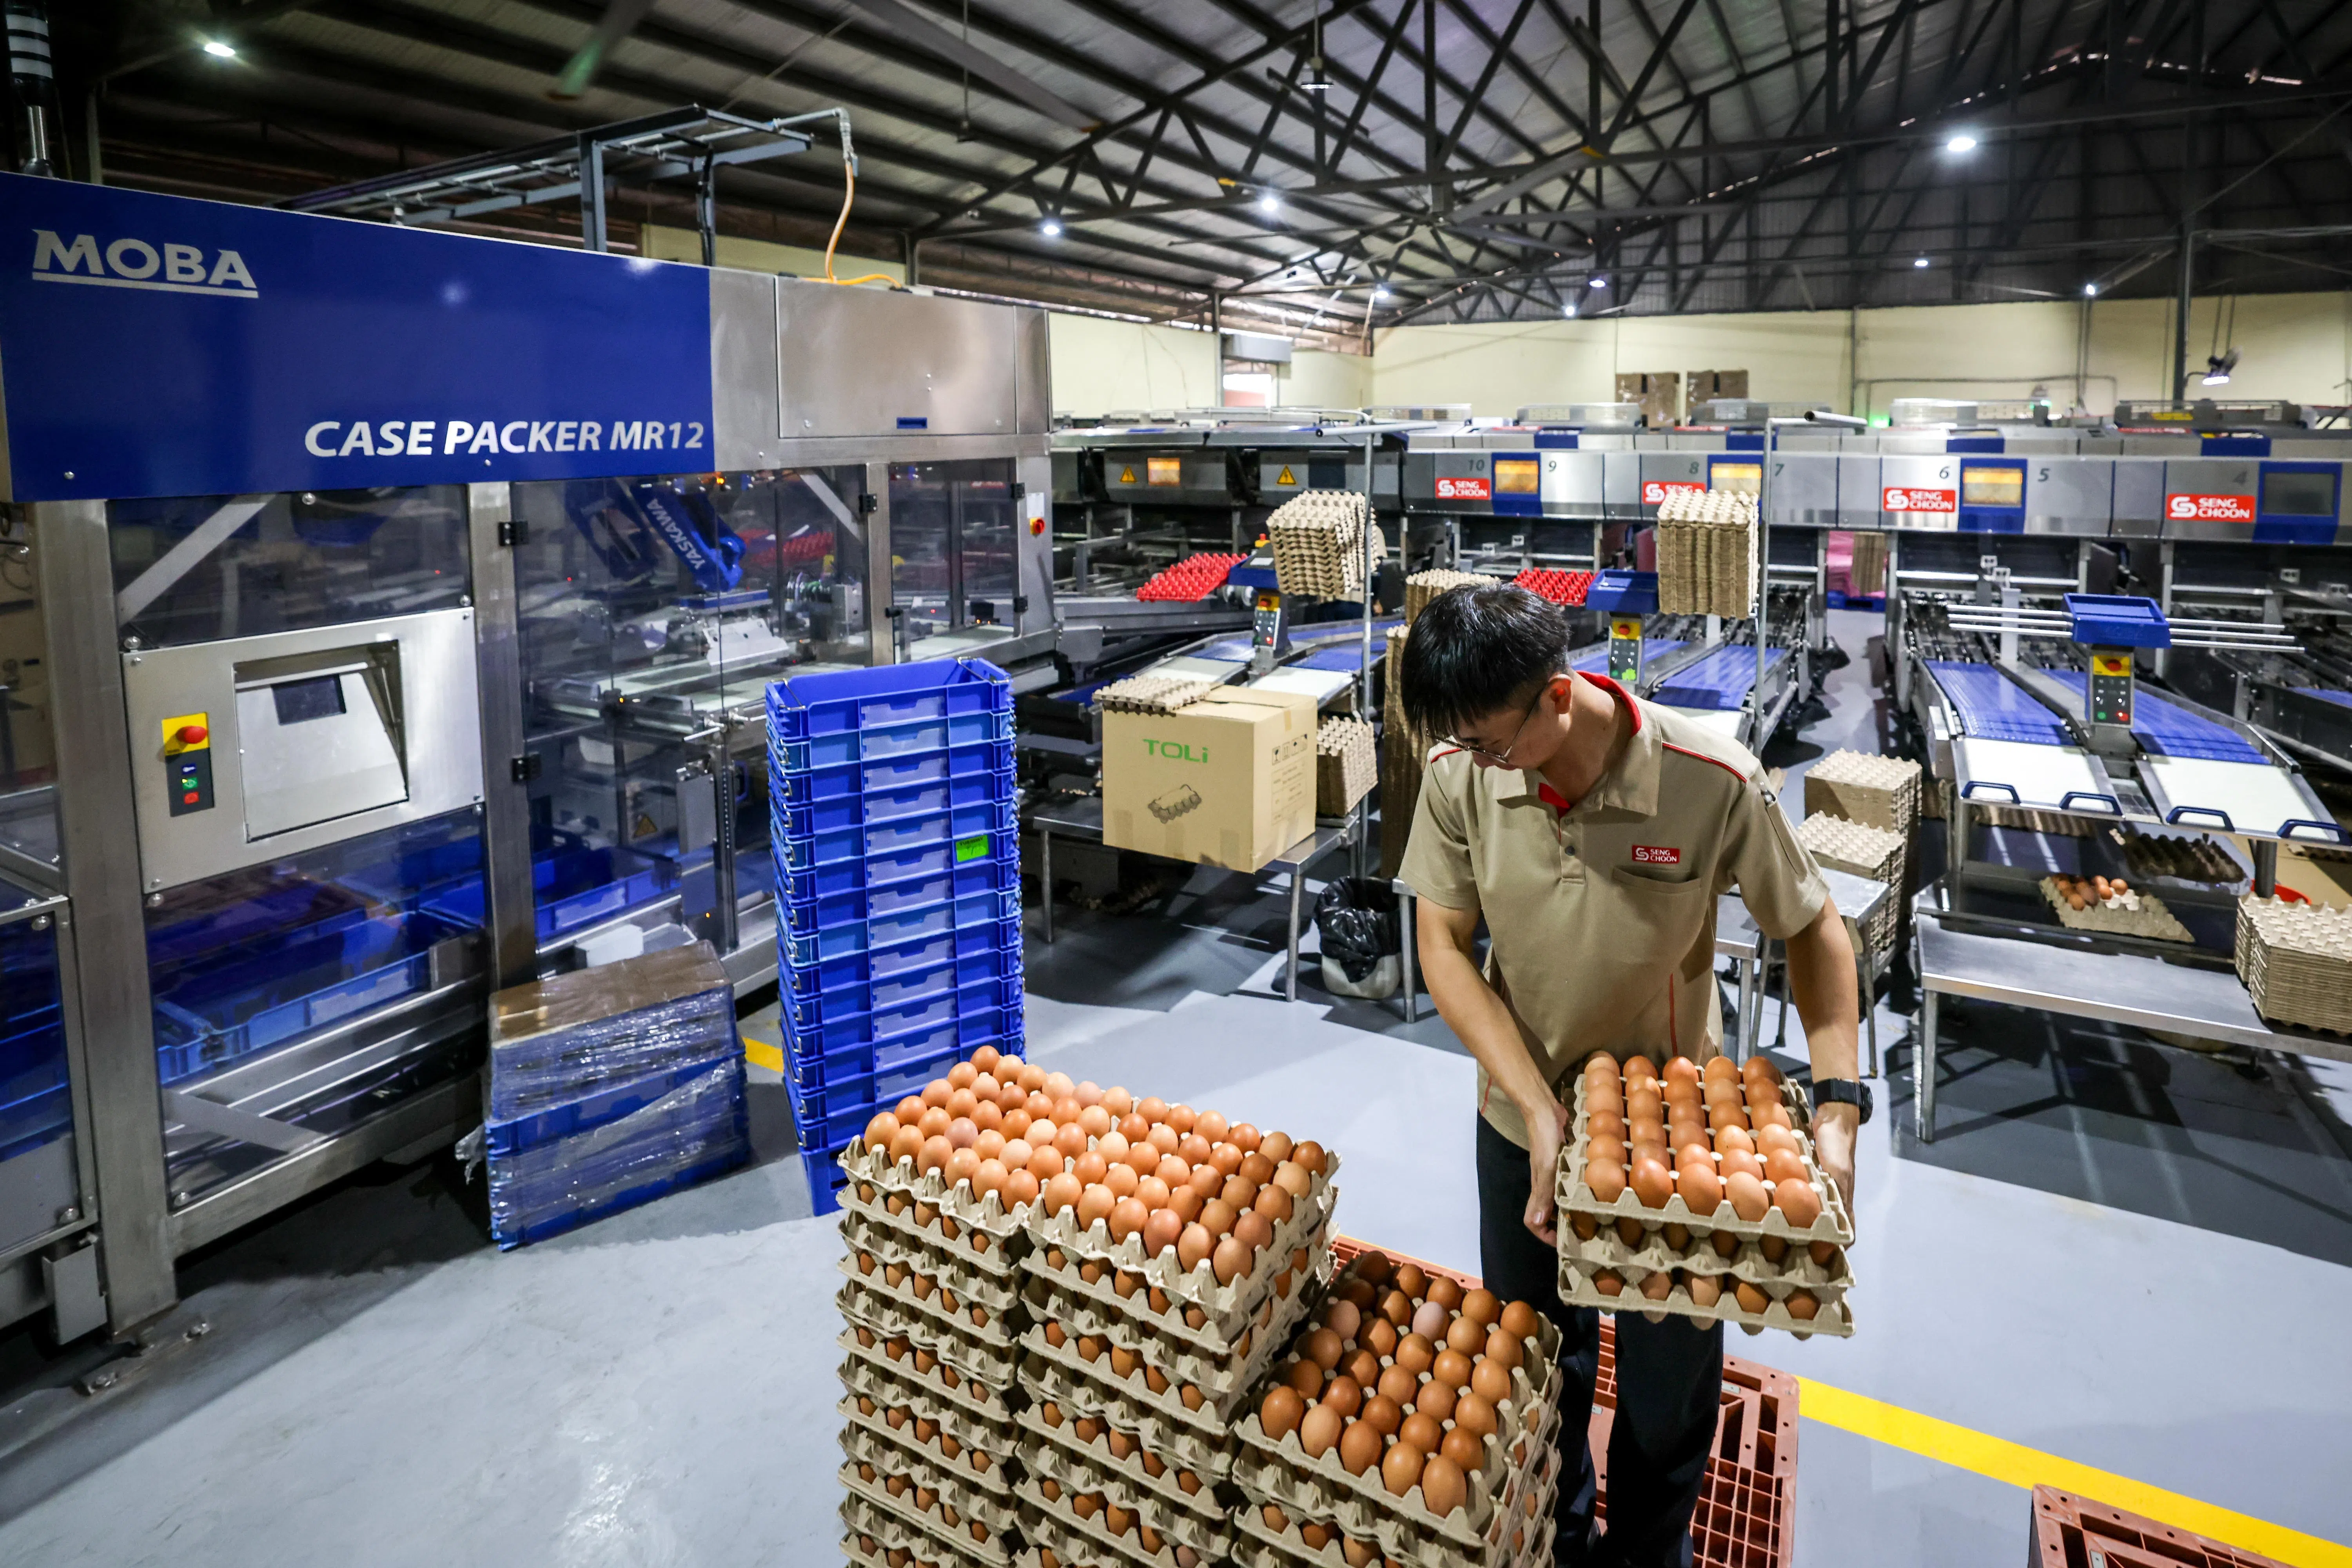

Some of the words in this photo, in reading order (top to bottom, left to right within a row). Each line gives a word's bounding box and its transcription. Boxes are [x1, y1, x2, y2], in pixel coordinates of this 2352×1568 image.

[32, 229, 257, 289] MOBA
[305, 420, 436, 457] CASE
[443, 421, 603, 455] PACKER
[610, 421, 705, 450] MR12
[1469, 459, 1485, 471] 10
[1549, 460, 1557, 472] 9
[1689, 461, 1699, 474] 8
[1775, 463, 1785, 477] 7
[1939, 466, 1950, 479] 6
[2038, 468, 2050, 482] 5
[2233, 471, 2247, 485] 4
[1909, 491, 1942, 500] SENG
[1909, 500, 1953, 510] CHOON
[2198, 497, 2237, 508] SENG
[2198, 508, 2250, 519] CHOON
[646, 498, 706, 570] YASKAWA
[1142, 739, 1208, 763] TOLi
